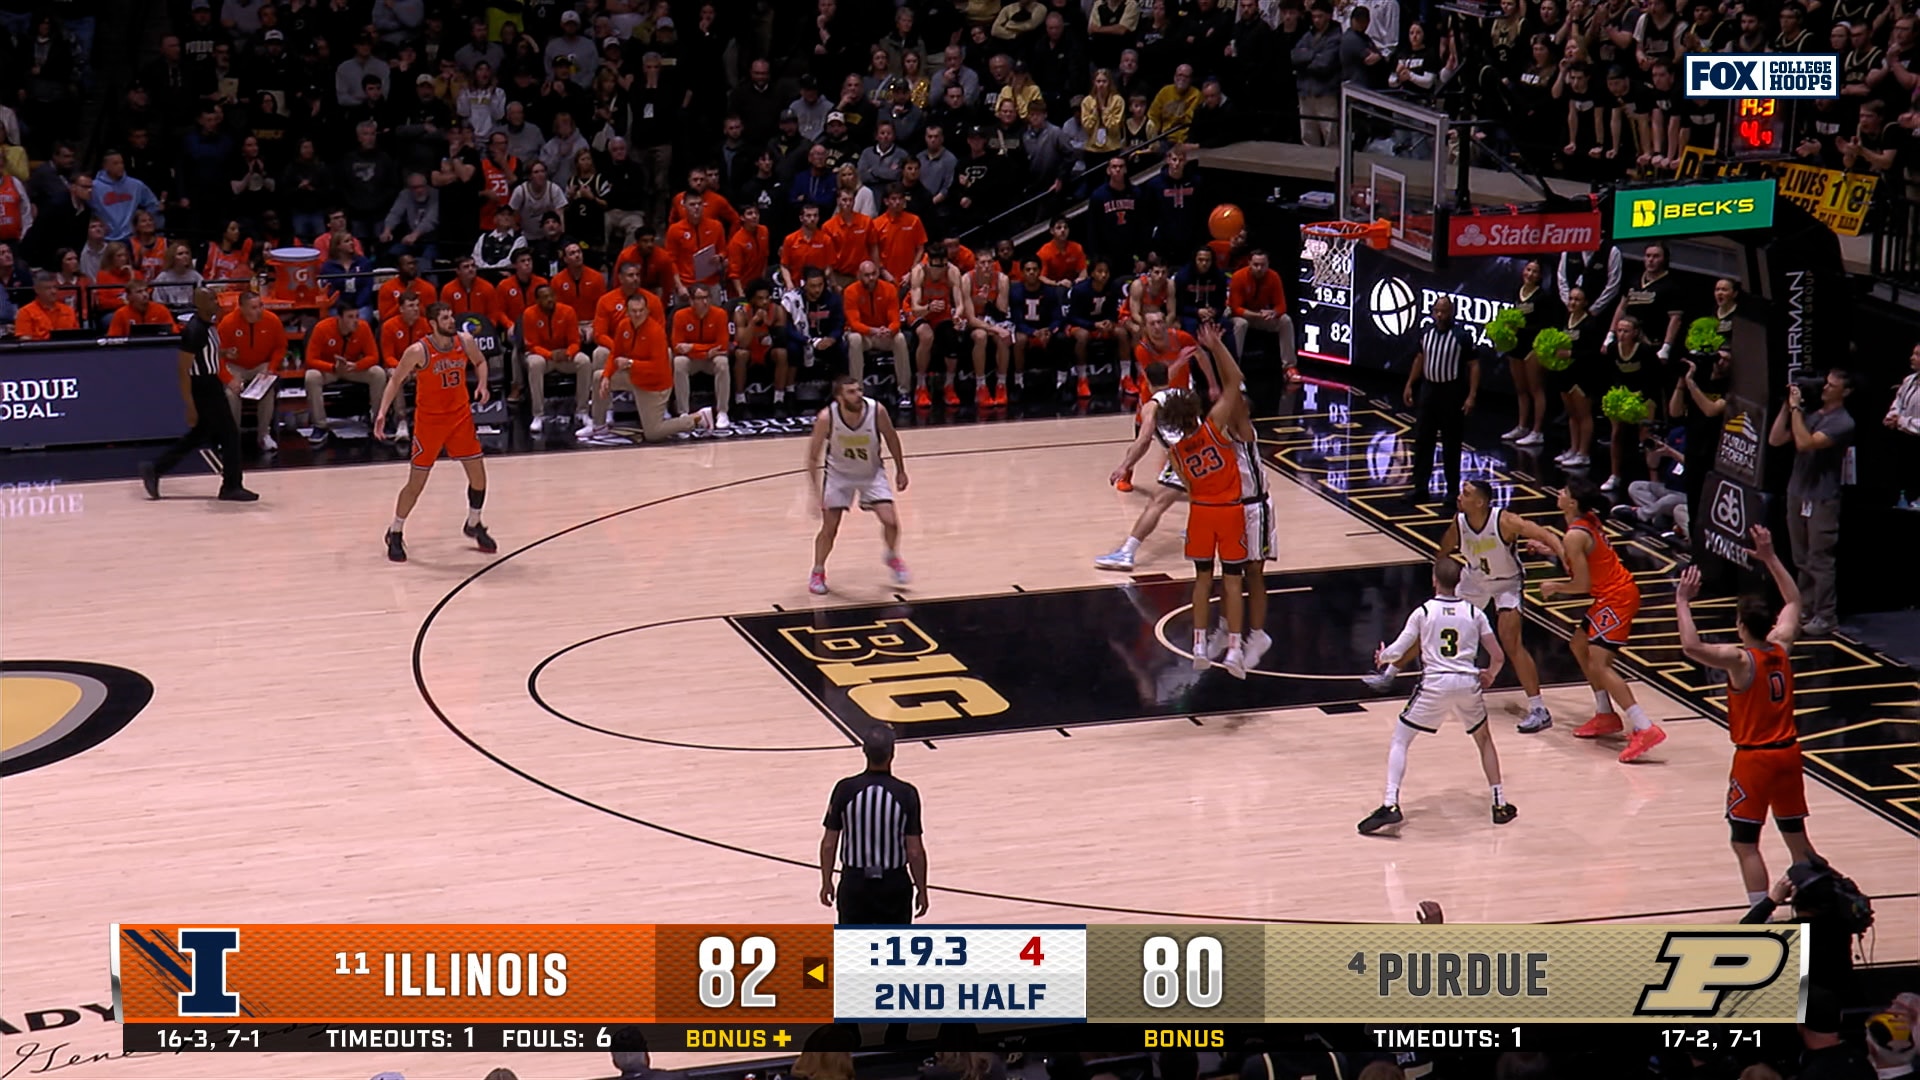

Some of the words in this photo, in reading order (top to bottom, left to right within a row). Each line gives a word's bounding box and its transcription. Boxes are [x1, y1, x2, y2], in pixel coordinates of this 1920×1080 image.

[1784, 168, 1828, 197] LIVES
[1663, 198, 1754, 219] BECK'S
[1314, 286, 1347, 305] 19.5
[1330, 322, 1351, 344] 82
[441, 371, 460, 388] 13
[842, 447, 869, 462] 45
[1186, 446, 1225, 478] 23
[1479, 557, 1490, 575] 4
[1440, 628, 1459, 658] 3
[1768, 670, 1785, 703] 0
